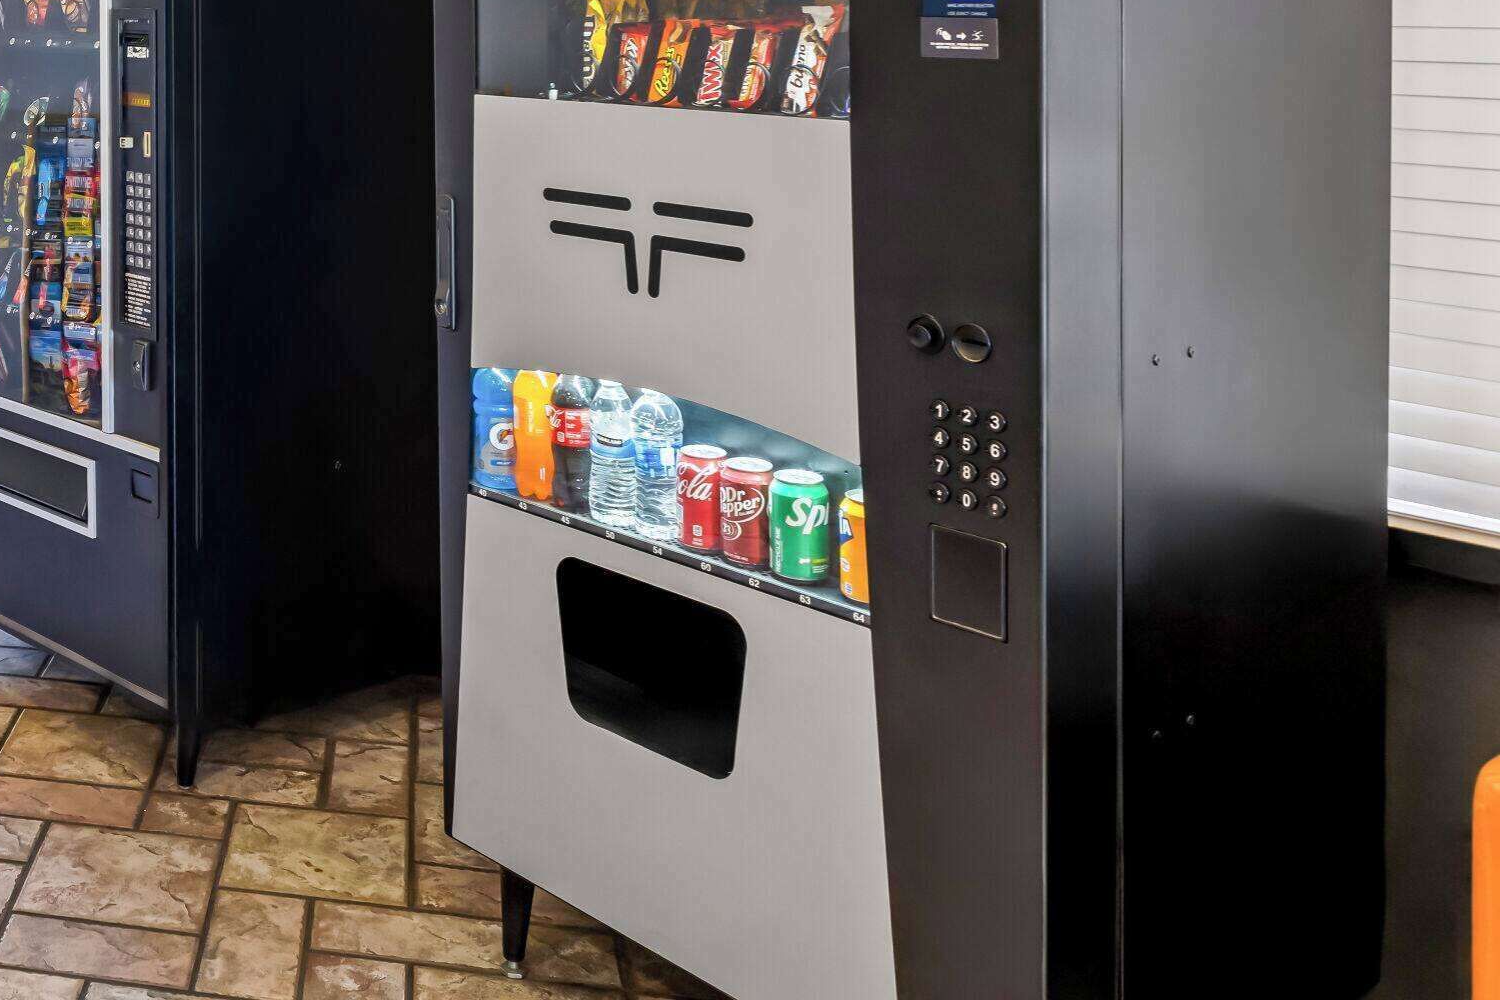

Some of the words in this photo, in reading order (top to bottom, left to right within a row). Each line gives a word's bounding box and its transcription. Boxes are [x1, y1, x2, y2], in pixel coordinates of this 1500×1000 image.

[697, 45, 723, 104] TWIX
[935, 403, 943, 418] 1
[962, 408, 972, 423] 2
[989, 414, 1000, 430] 3
[933, 431, 944, 445] 4
[962, 437, 972, 451] 5
[989, 443, 1000, 458] 6
[935, 458, 944, 473] 7
[961, 465, 972, 480] 8
[677, 463, 714, 502] ola
[989, 471, 1000, 487] 9
[721, 496, 762, 519] epper
[962, 493, 971, 507] 0
[561, 516, 571, 524] 45
[652, 545, 663, 556] 54
[749, 578, 761, 589] 62
[799, 594, 811, 605] 63
[853, 612, 866, 623] 64
